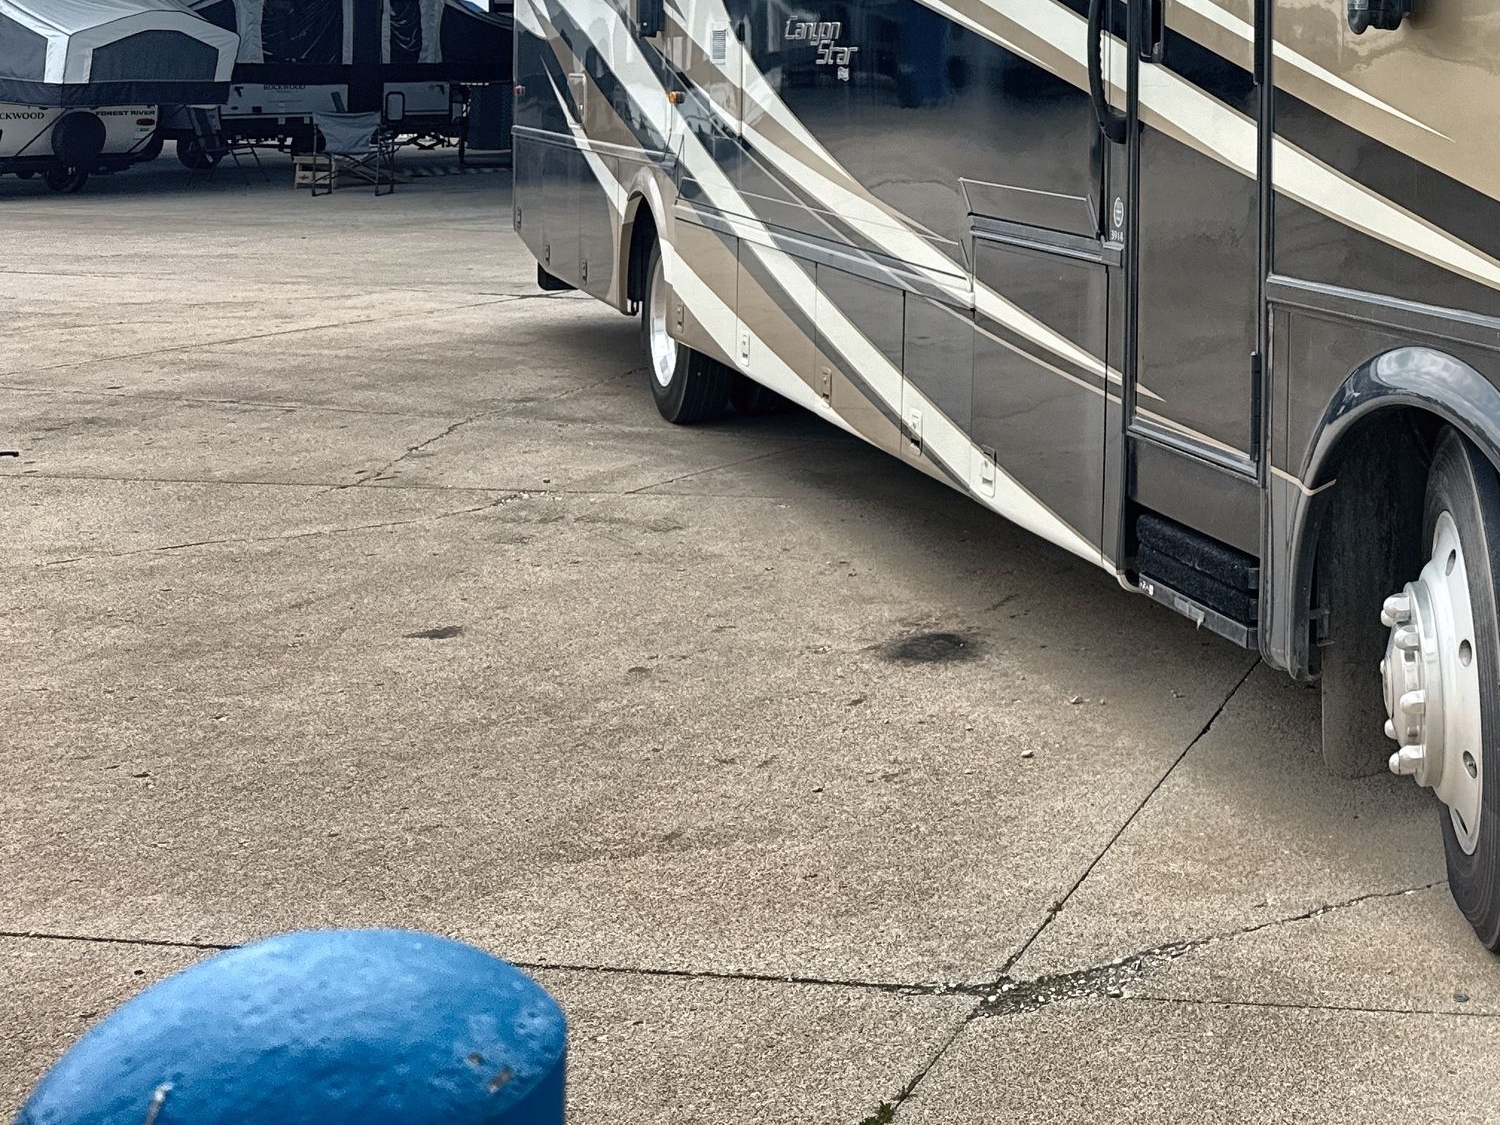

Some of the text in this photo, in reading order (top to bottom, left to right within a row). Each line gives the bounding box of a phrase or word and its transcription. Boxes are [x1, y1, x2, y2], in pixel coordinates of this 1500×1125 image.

[784, 15, 843, 46] Canyon
[816, 40, 859, 65] Star
[1110, 230, 1124, 242] 3914
